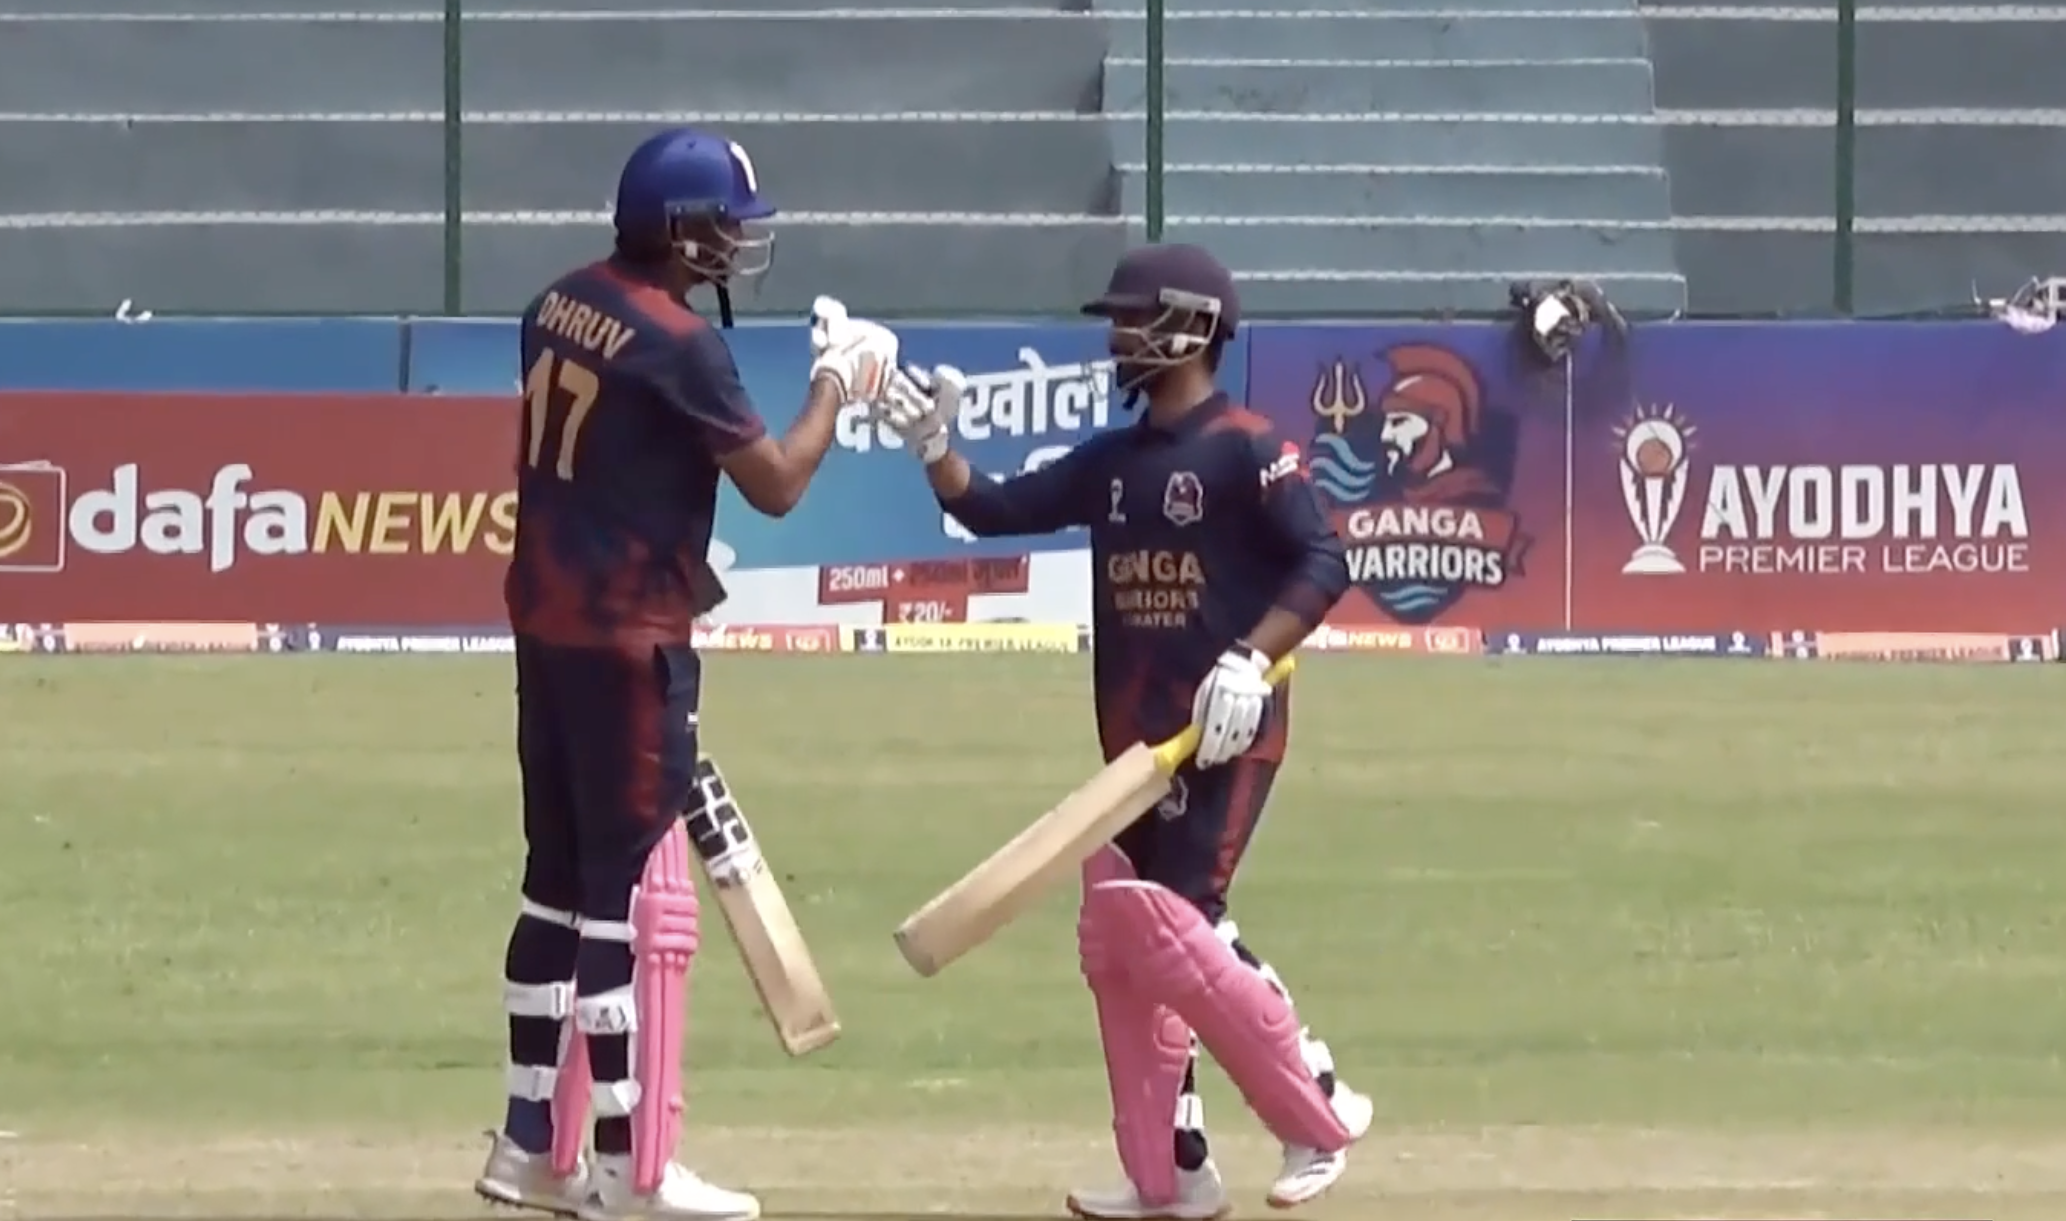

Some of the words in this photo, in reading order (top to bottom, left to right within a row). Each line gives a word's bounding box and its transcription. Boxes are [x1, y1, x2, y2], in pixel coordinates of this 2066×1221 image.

[536, 291, 636, 360] DHRUV
[526, 347, 599, 482] 17
[1348, 506, 1484, 540] GANGA
[1701, 464, 2029, 539] AYODHYA
[828, 564, 889, 591] 250ml
[1699, 546, 1866, 573] PREMIER
[1883, 543, 2030, 572] LEAGUE
